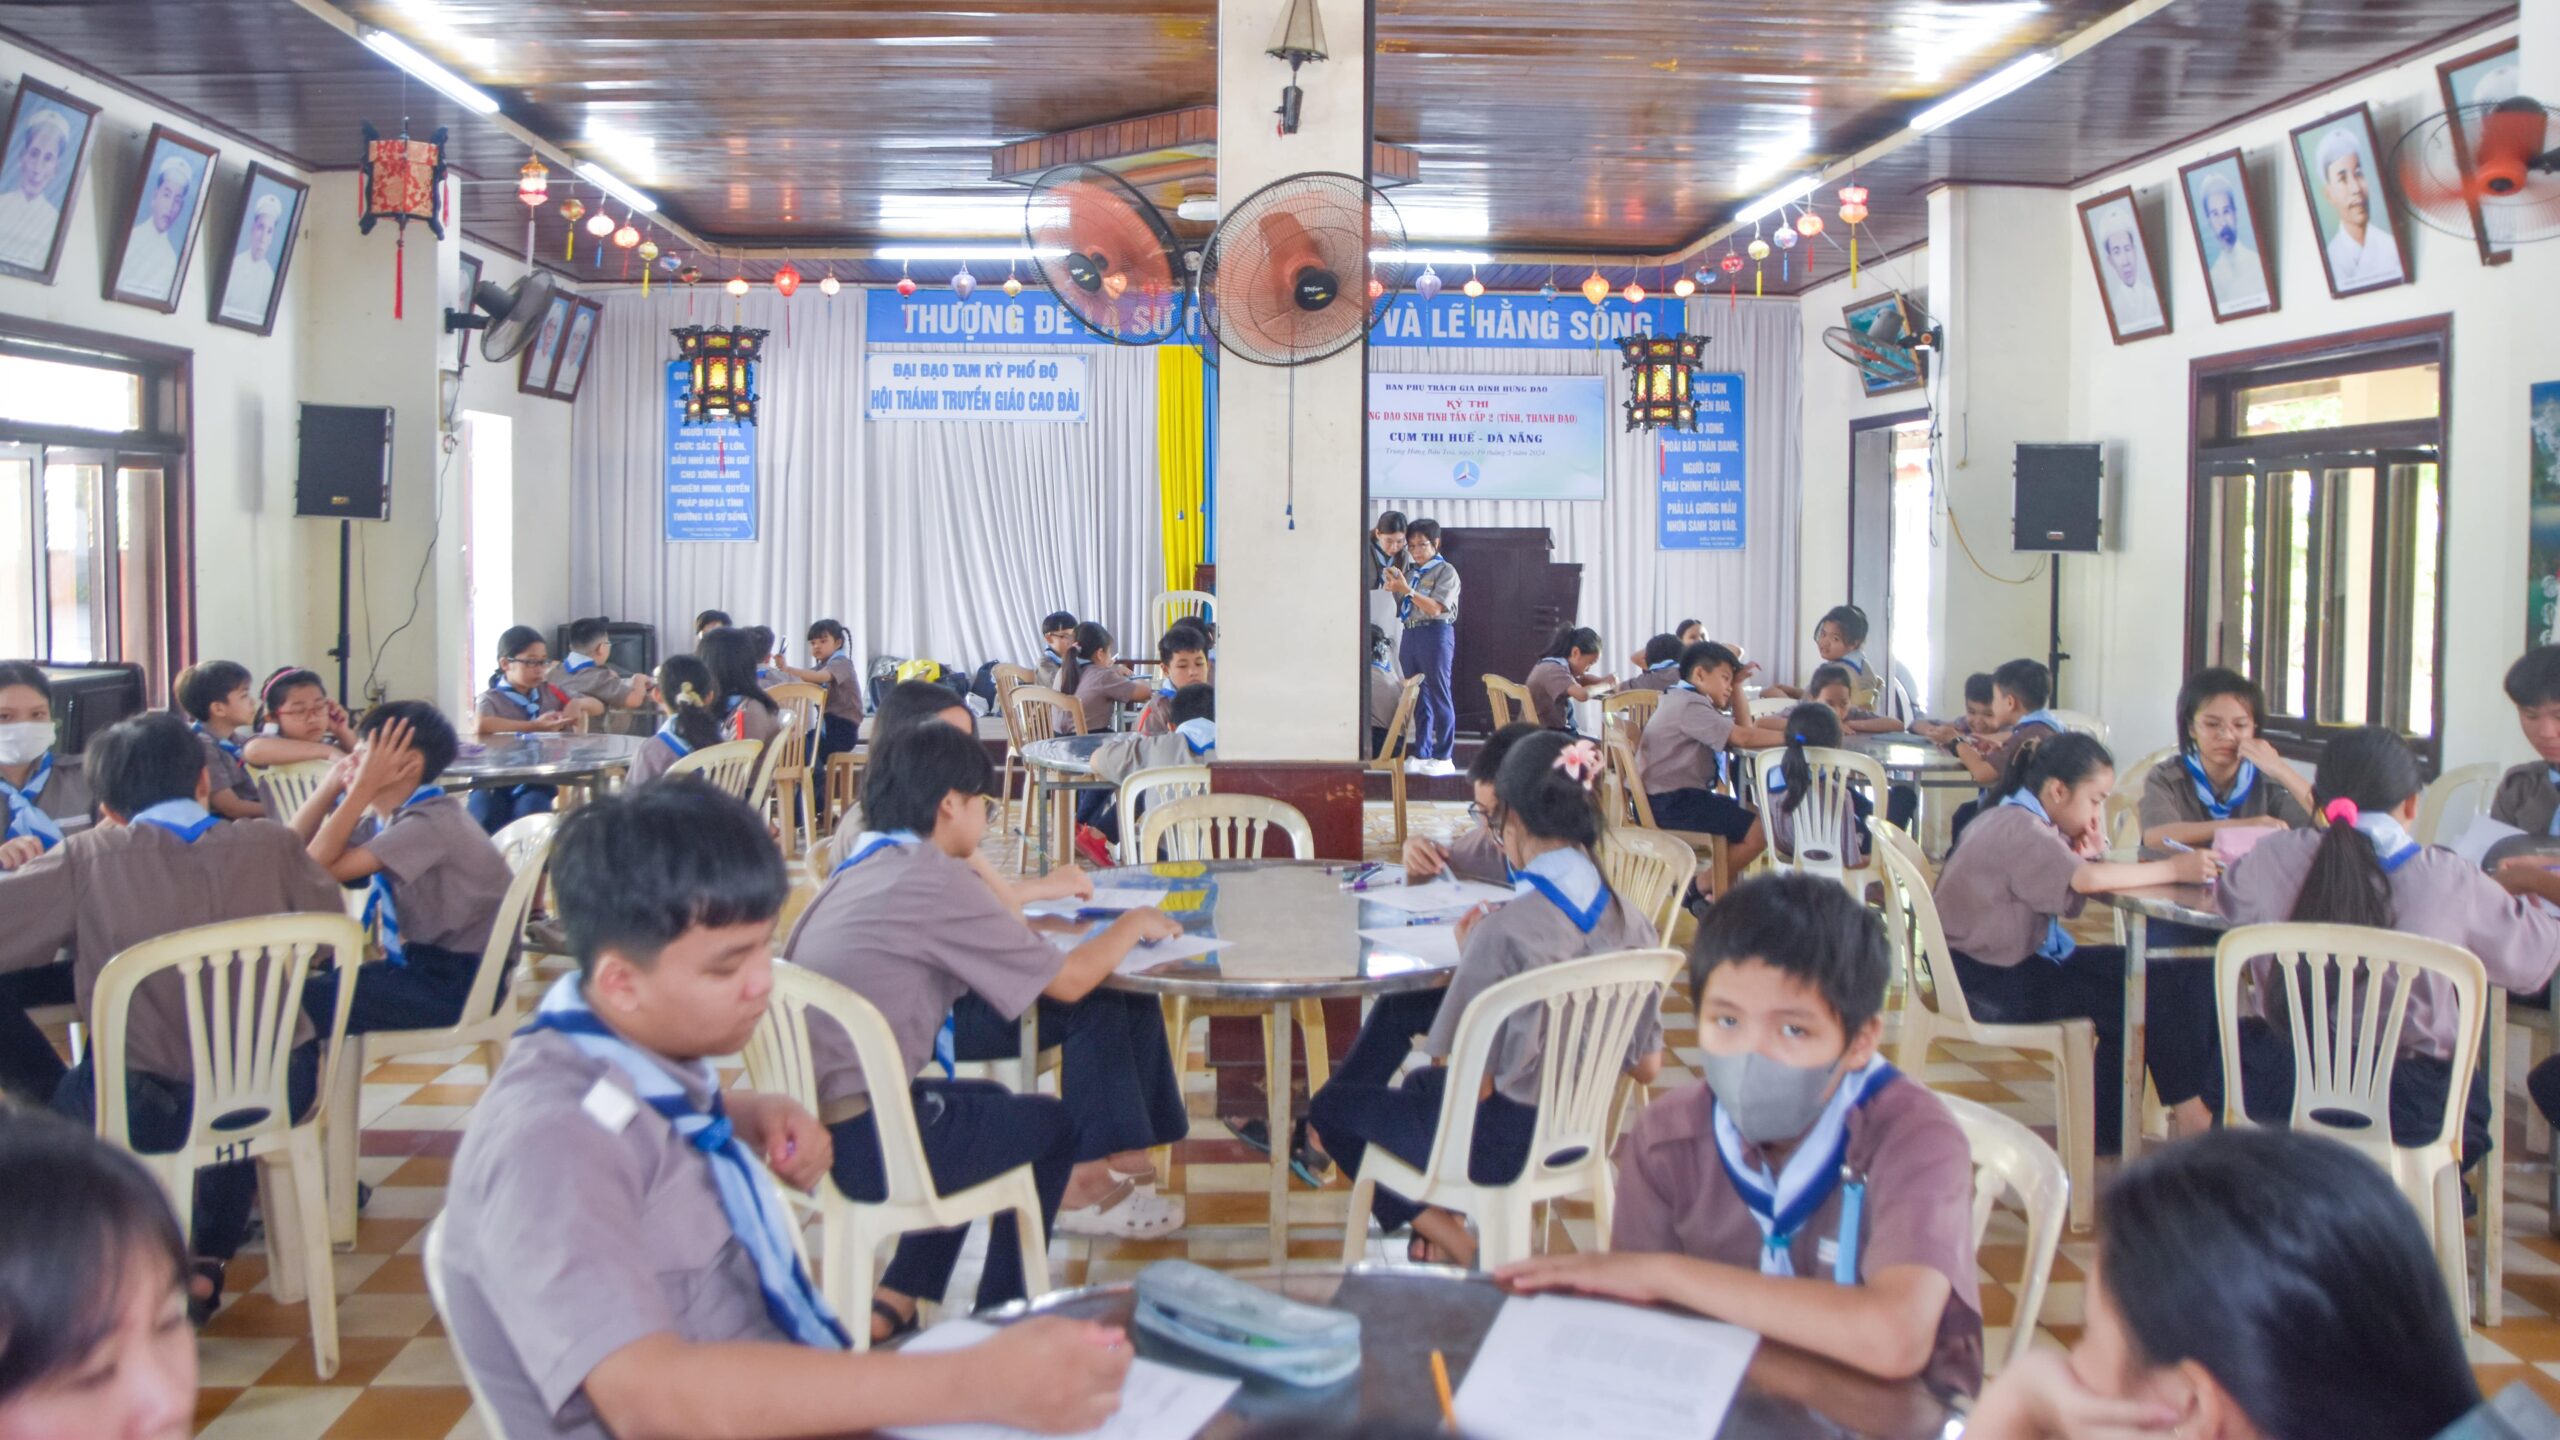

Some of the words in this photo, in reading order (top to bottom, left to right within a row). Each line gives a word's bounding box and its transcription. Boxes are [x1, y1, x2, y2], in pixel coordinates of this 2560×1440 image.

[902, 301, 1024, 340] THƯỢNG
[1383, 302, 1421, 338] VÀ
[1431, 302, 1465, 338] LẼ
[1476, 298, 1559, 339] HẰNG
[1570, 300, 1653, 340] SỐNG
[920, 363, 948, 380] ĐẠO
[953, 364, 981, 378] TAM
[985, 361, 1003, 378] KỲ
[871, 386, 893, 414] HỘI
[896, 386, 938, 411] THÁNH
[995, 387, 1025, 411] GIÁO
[1028, 391, 1053, 411] CAO
[1058, 387, 1080, 411] ĐÀI
[1469, 400, 1489, 409] THI
[1403, 412, 1424, 421] SINH
[1488, 413, 1494, 423] 2
[1389, 431, 1417, 443] CỤM
[1421, 433, 1444, 442] THI
[1449, 430, 1477, 443] HUẾ
[1705, 462, 1721, 474] CON
